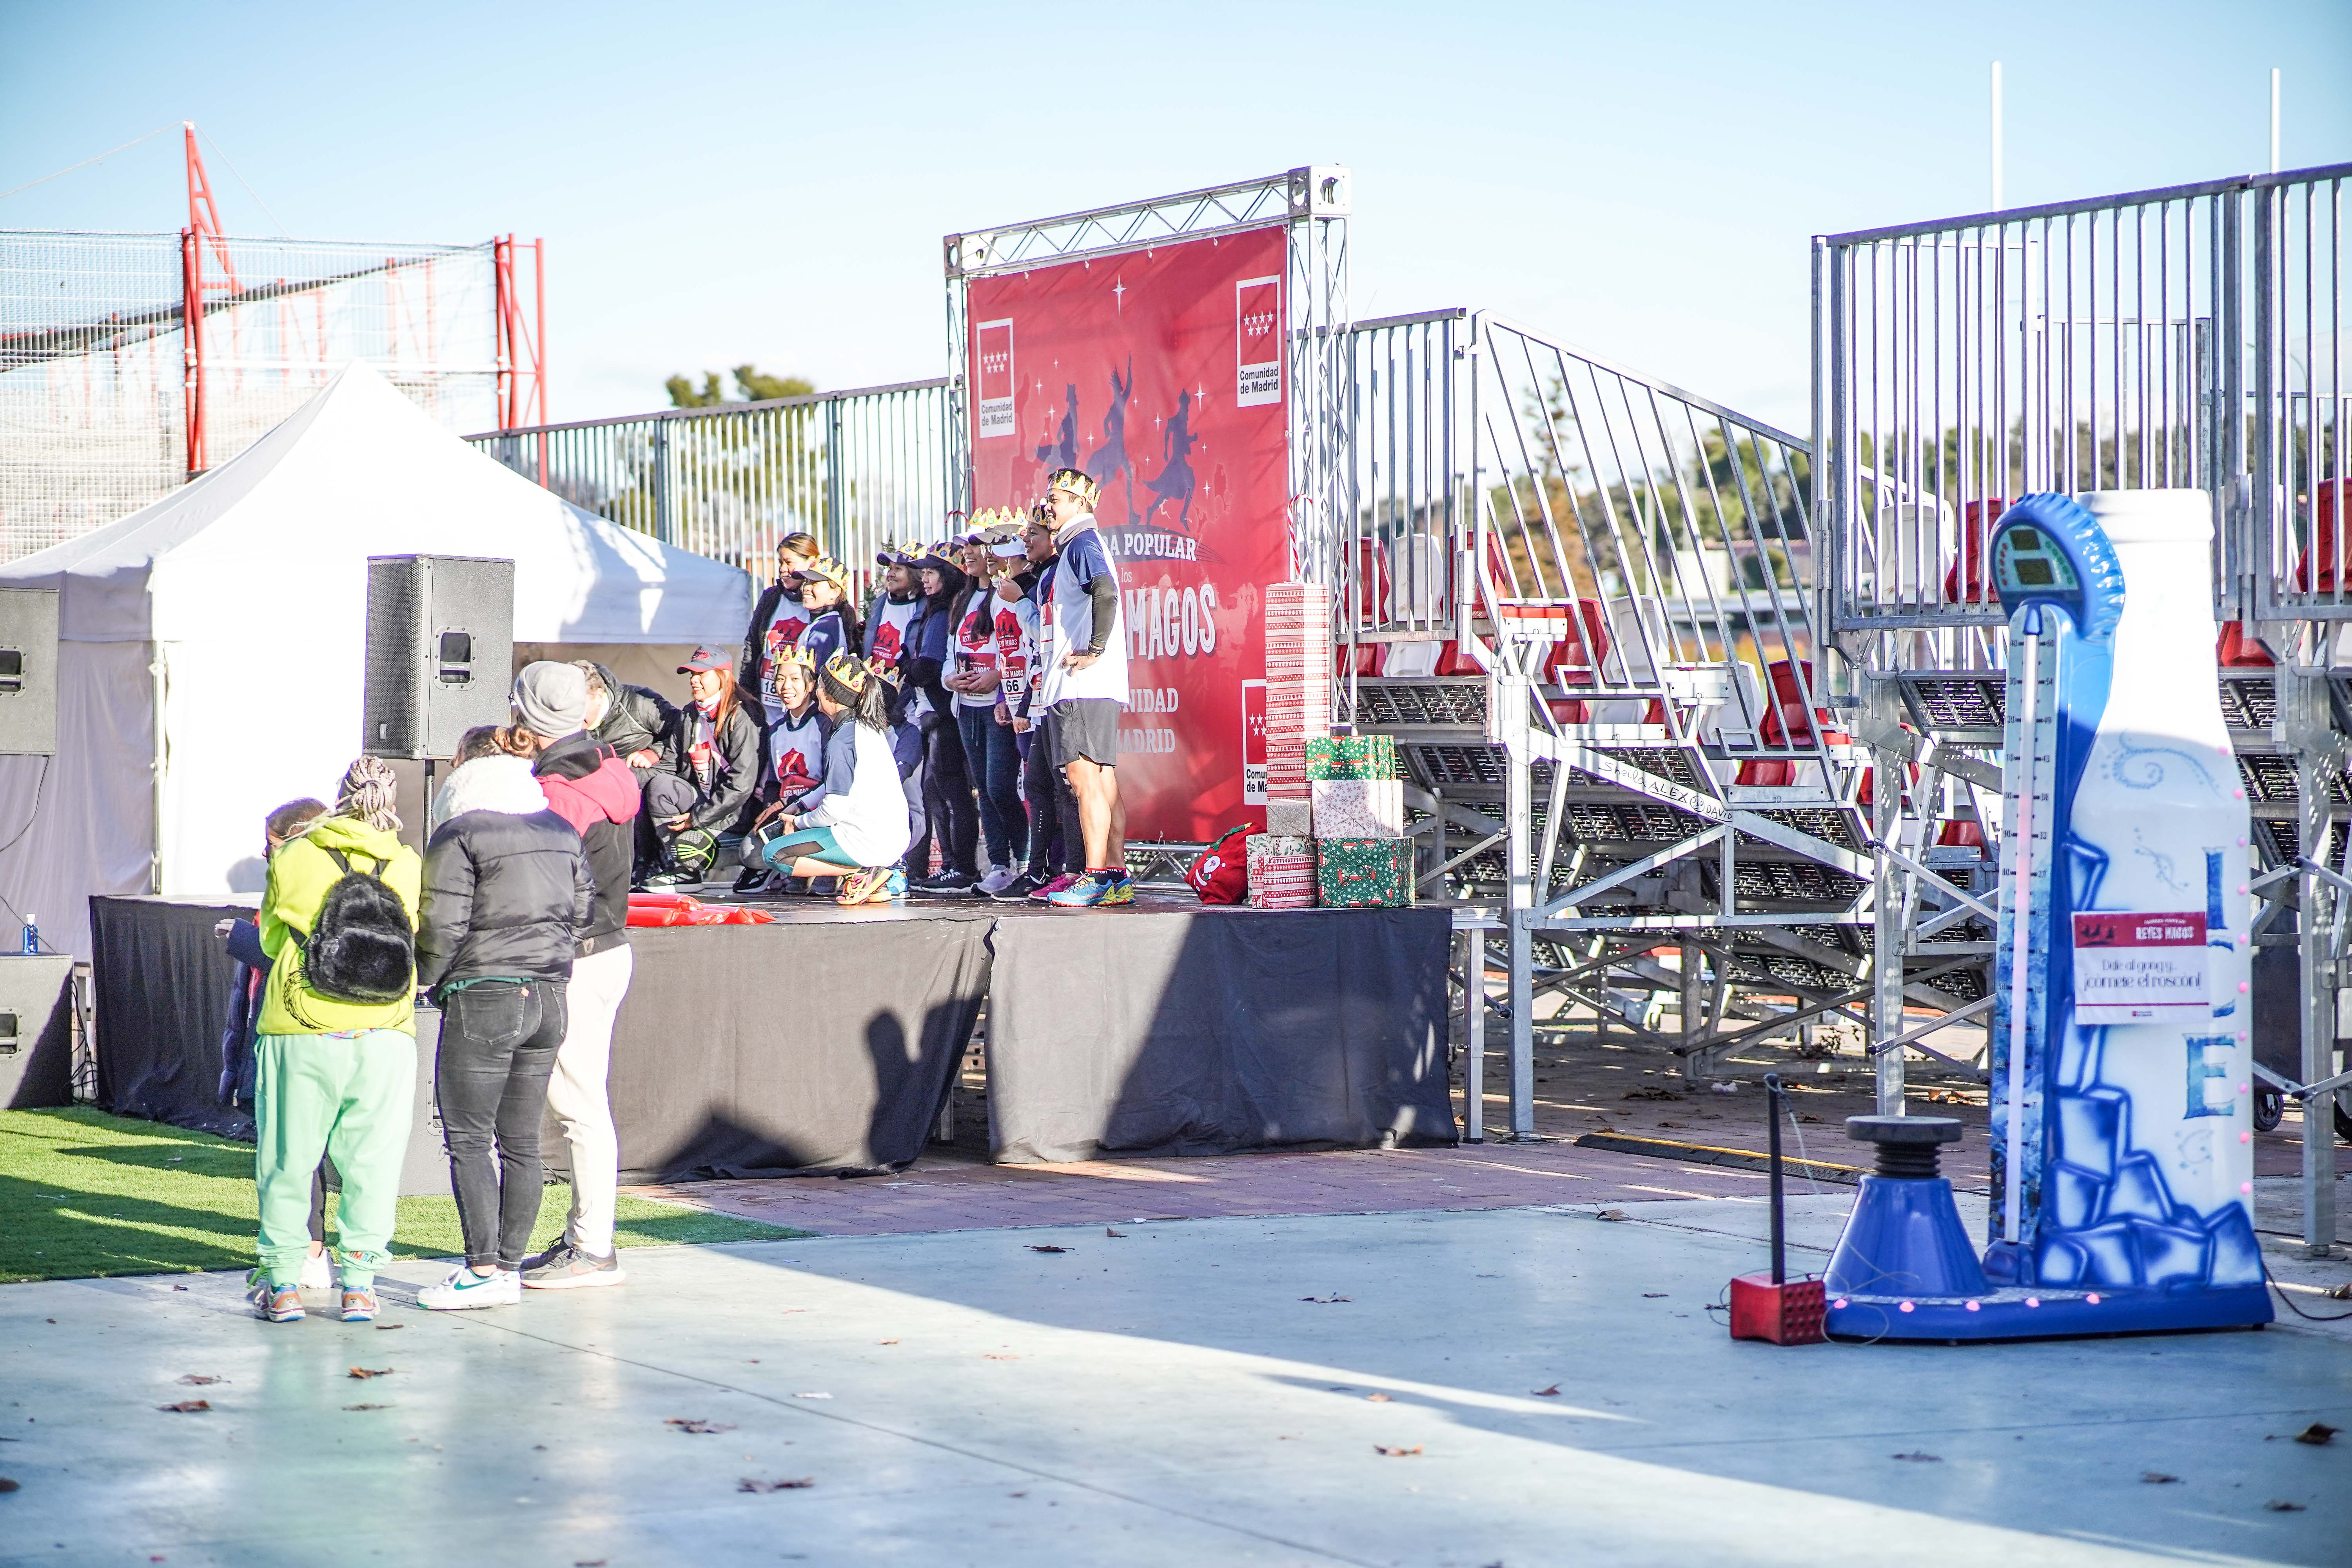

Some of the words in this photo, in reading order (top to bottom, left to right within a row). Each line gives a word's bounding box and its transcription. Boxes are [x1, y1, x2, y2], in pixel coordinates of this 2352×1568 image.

[1240, 366, 1278, 381] Comunidad
[1240, 383, 1249, 394] de
[1252, 379, 1278, 393] Madrid
[982, 401, 1012, 414] Comunidad
[982, 416, 989, 426] de
[991, 412, 1012, 425] Madrid
[1124, 533, 1196, 562] POPULAR
[1121, 568, 1132, 583] los
[1125, 583, 1216, 660] MAGOS
[766, 681, 776, 694] 18
[1006, 679, 1019, 692] 66
[1120, 688, 1179, 713] NIDAD
[1247, 781, 1256, 792] de
[1599, 762, 1646, 787] Sheila
[1648, 782, 1688, 803] ALEX
[2136, 926, 2163, 940] REYES
[2165, 926, 2194, 940] MAGOS
[2102, 959, 2121, 971] Dale
[2137, 973, 2149, 988] el
